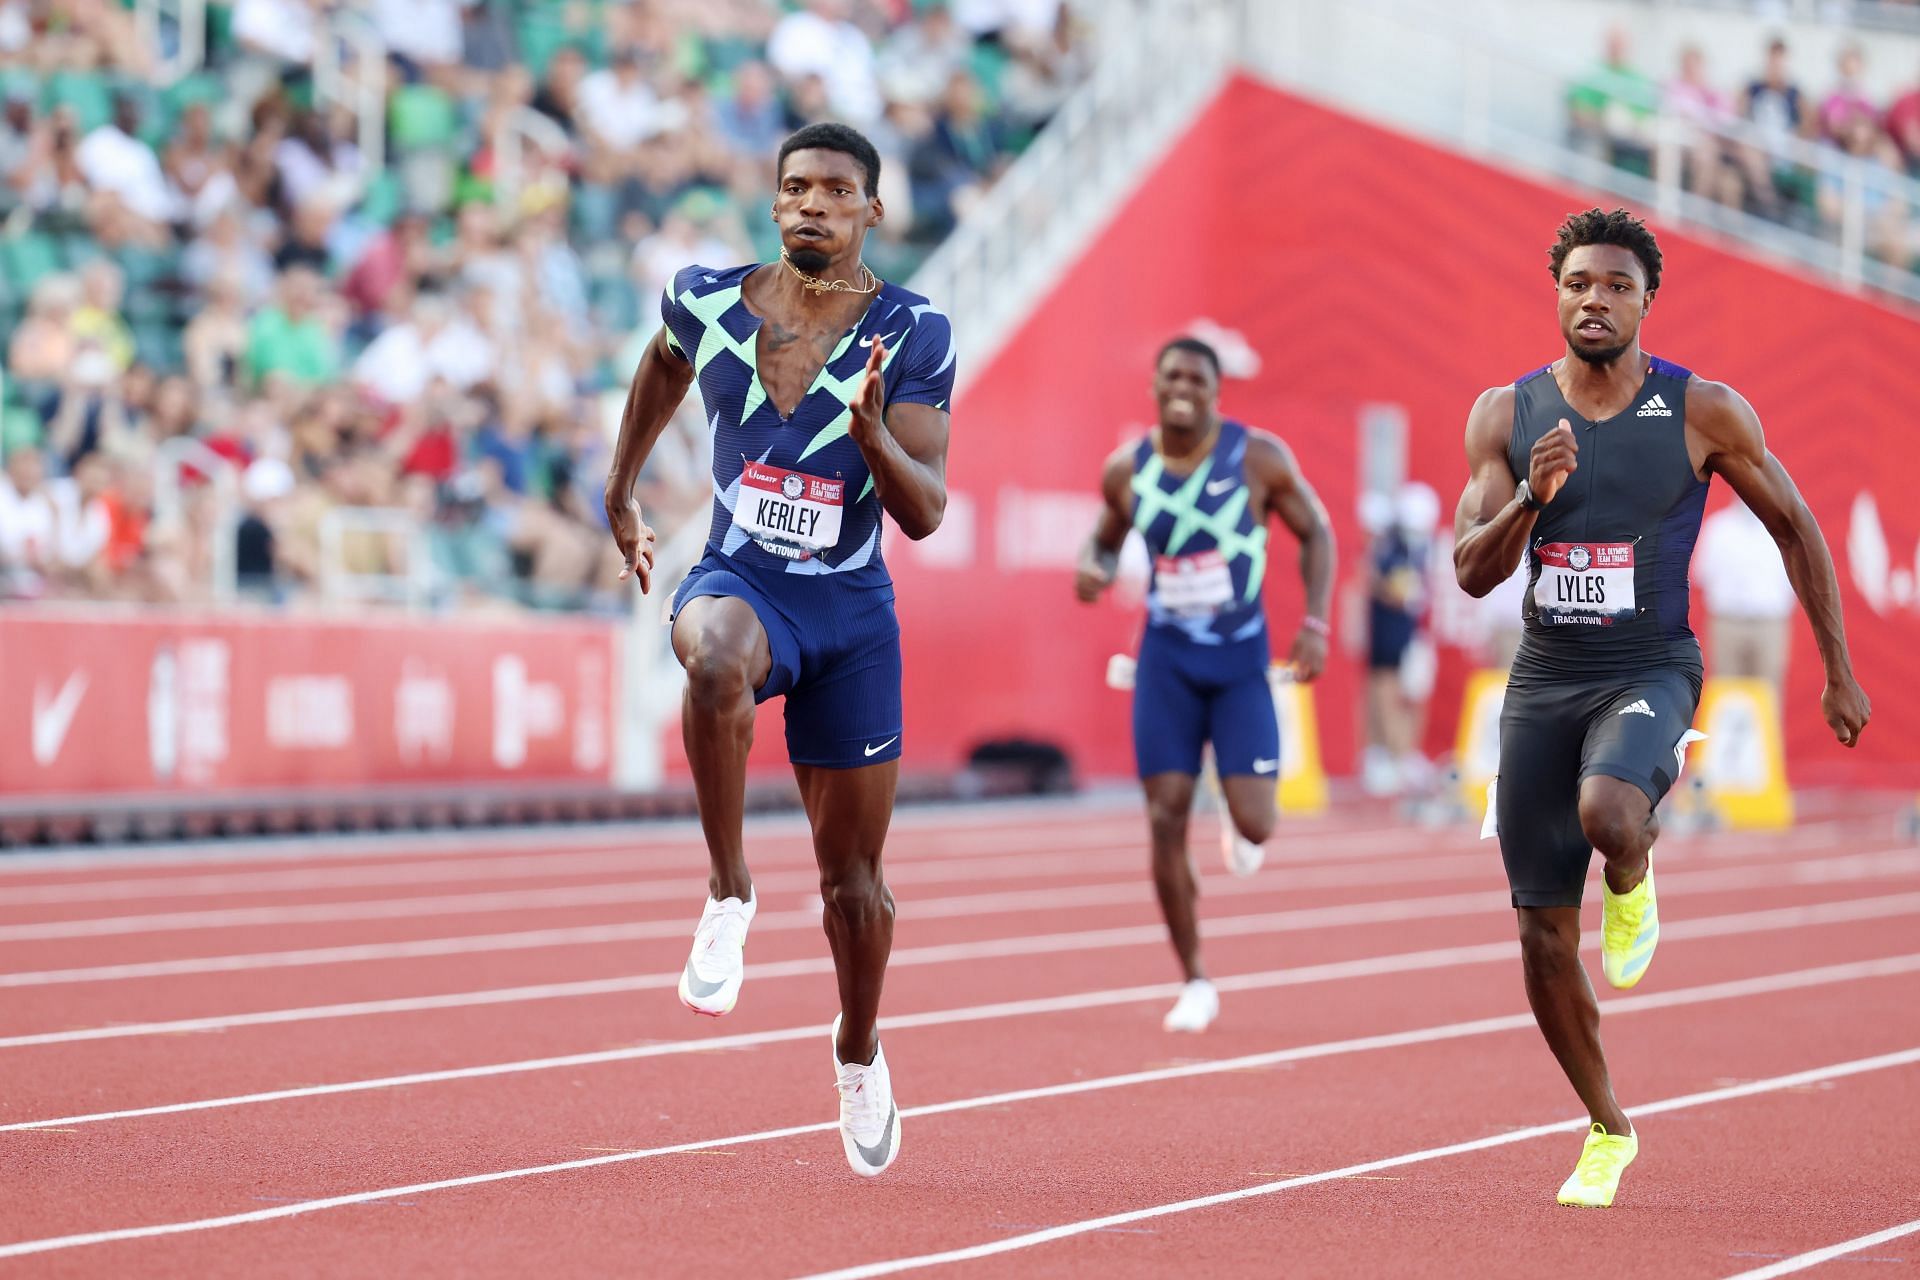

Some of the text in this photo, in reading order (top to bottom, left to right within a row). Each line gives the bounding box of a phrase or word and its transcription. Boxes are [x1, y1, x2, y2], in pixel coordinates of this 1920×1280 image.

[1636, 408, 1672, 417] adidas
[810, 487, 824, 497] TEAM
[756, 498, 821, 537] KERLEY
[1597, 547, 1629, 555] U.S. OLYMPIC
[1597, 555, 1628, 563] TEAM TRIALS
[1556, 574, 1605, 604] LYLES
